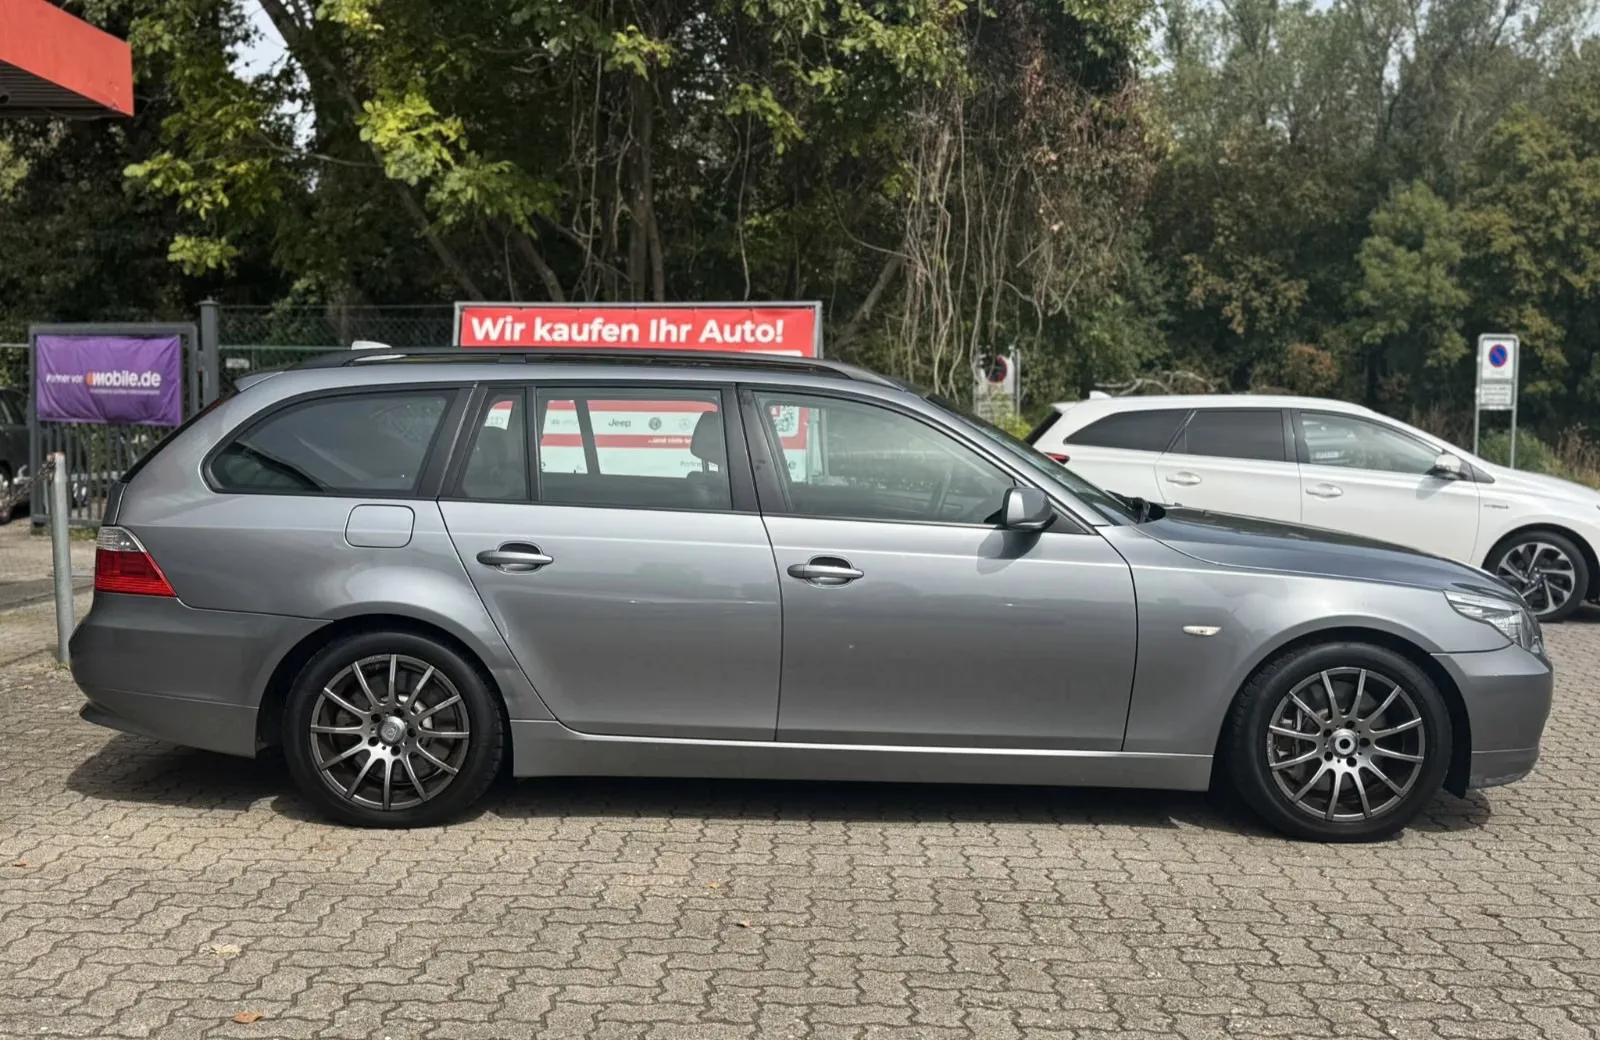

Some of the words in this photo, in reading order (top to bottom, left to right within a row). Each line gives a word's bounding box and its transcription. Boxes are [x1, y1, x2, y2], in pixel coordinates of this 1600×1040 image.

[471, 315, 525, 341] Wir
[533, 317, 640, 343] kaufen
[649, 319, 692, 343] Ihr
[699, 319, 784, 344] Auto!
[93, 370, 161, 386] mobile.de
[608, 418, 631, 428] Jeep
